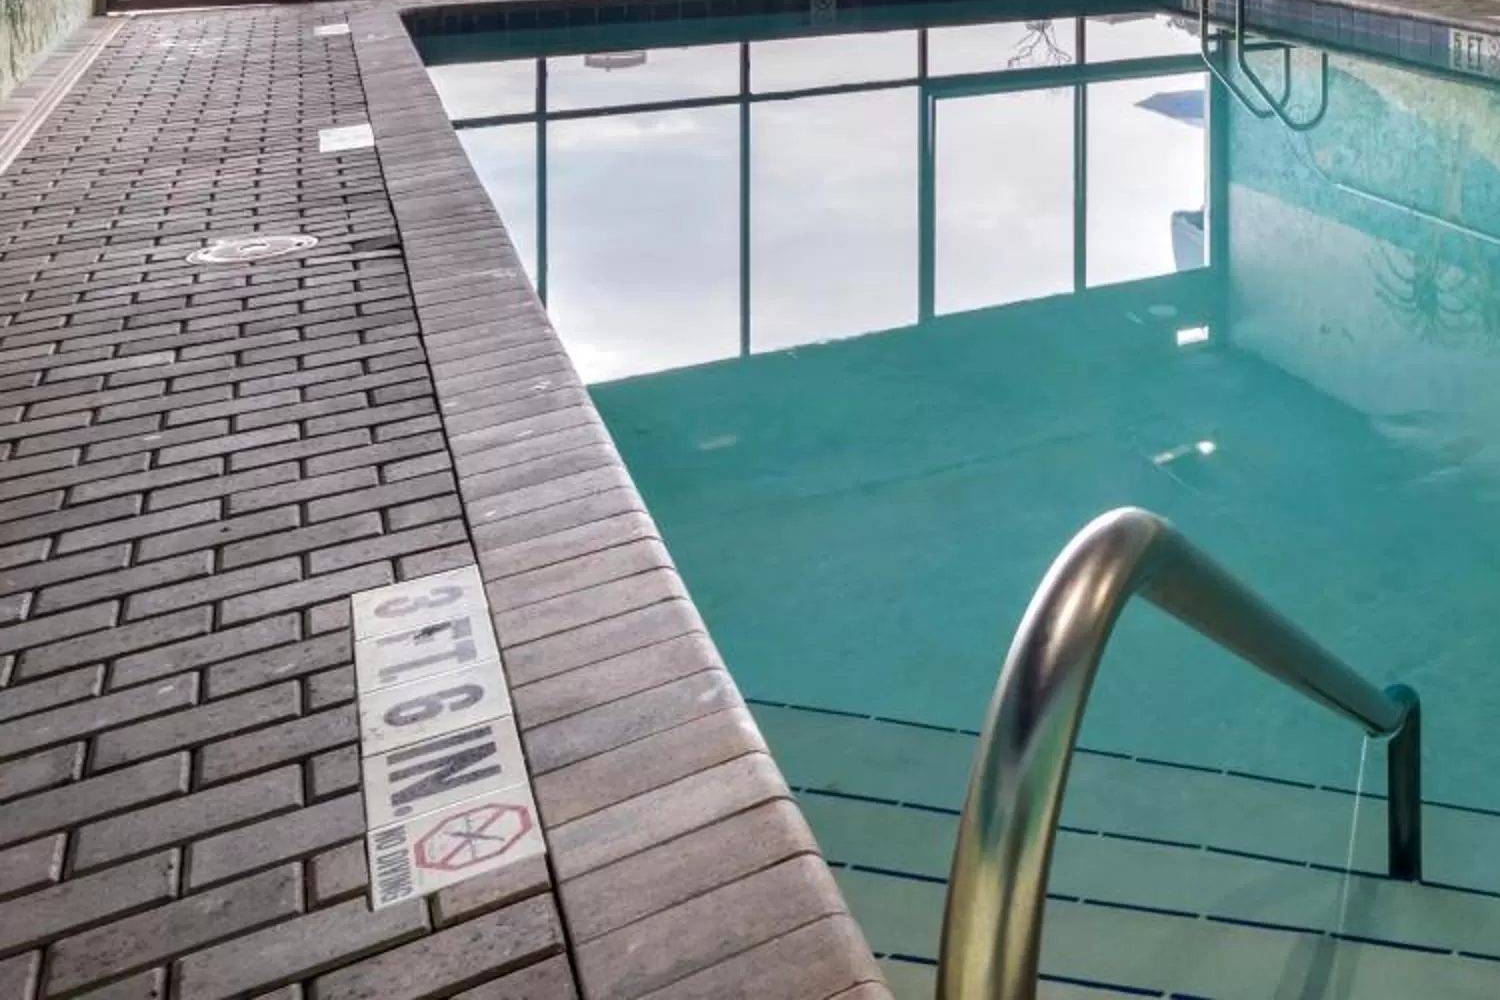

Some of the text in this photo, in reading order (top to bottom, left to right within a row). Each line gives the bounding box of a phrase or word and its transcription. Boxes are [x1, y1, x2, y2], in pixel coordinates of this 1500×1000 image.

[374, 585, 464, 619] 3
[384, 684, 485, 727] 6
[386, 726, 502, 817] IN.
[375, 825, 406, 851] NO
